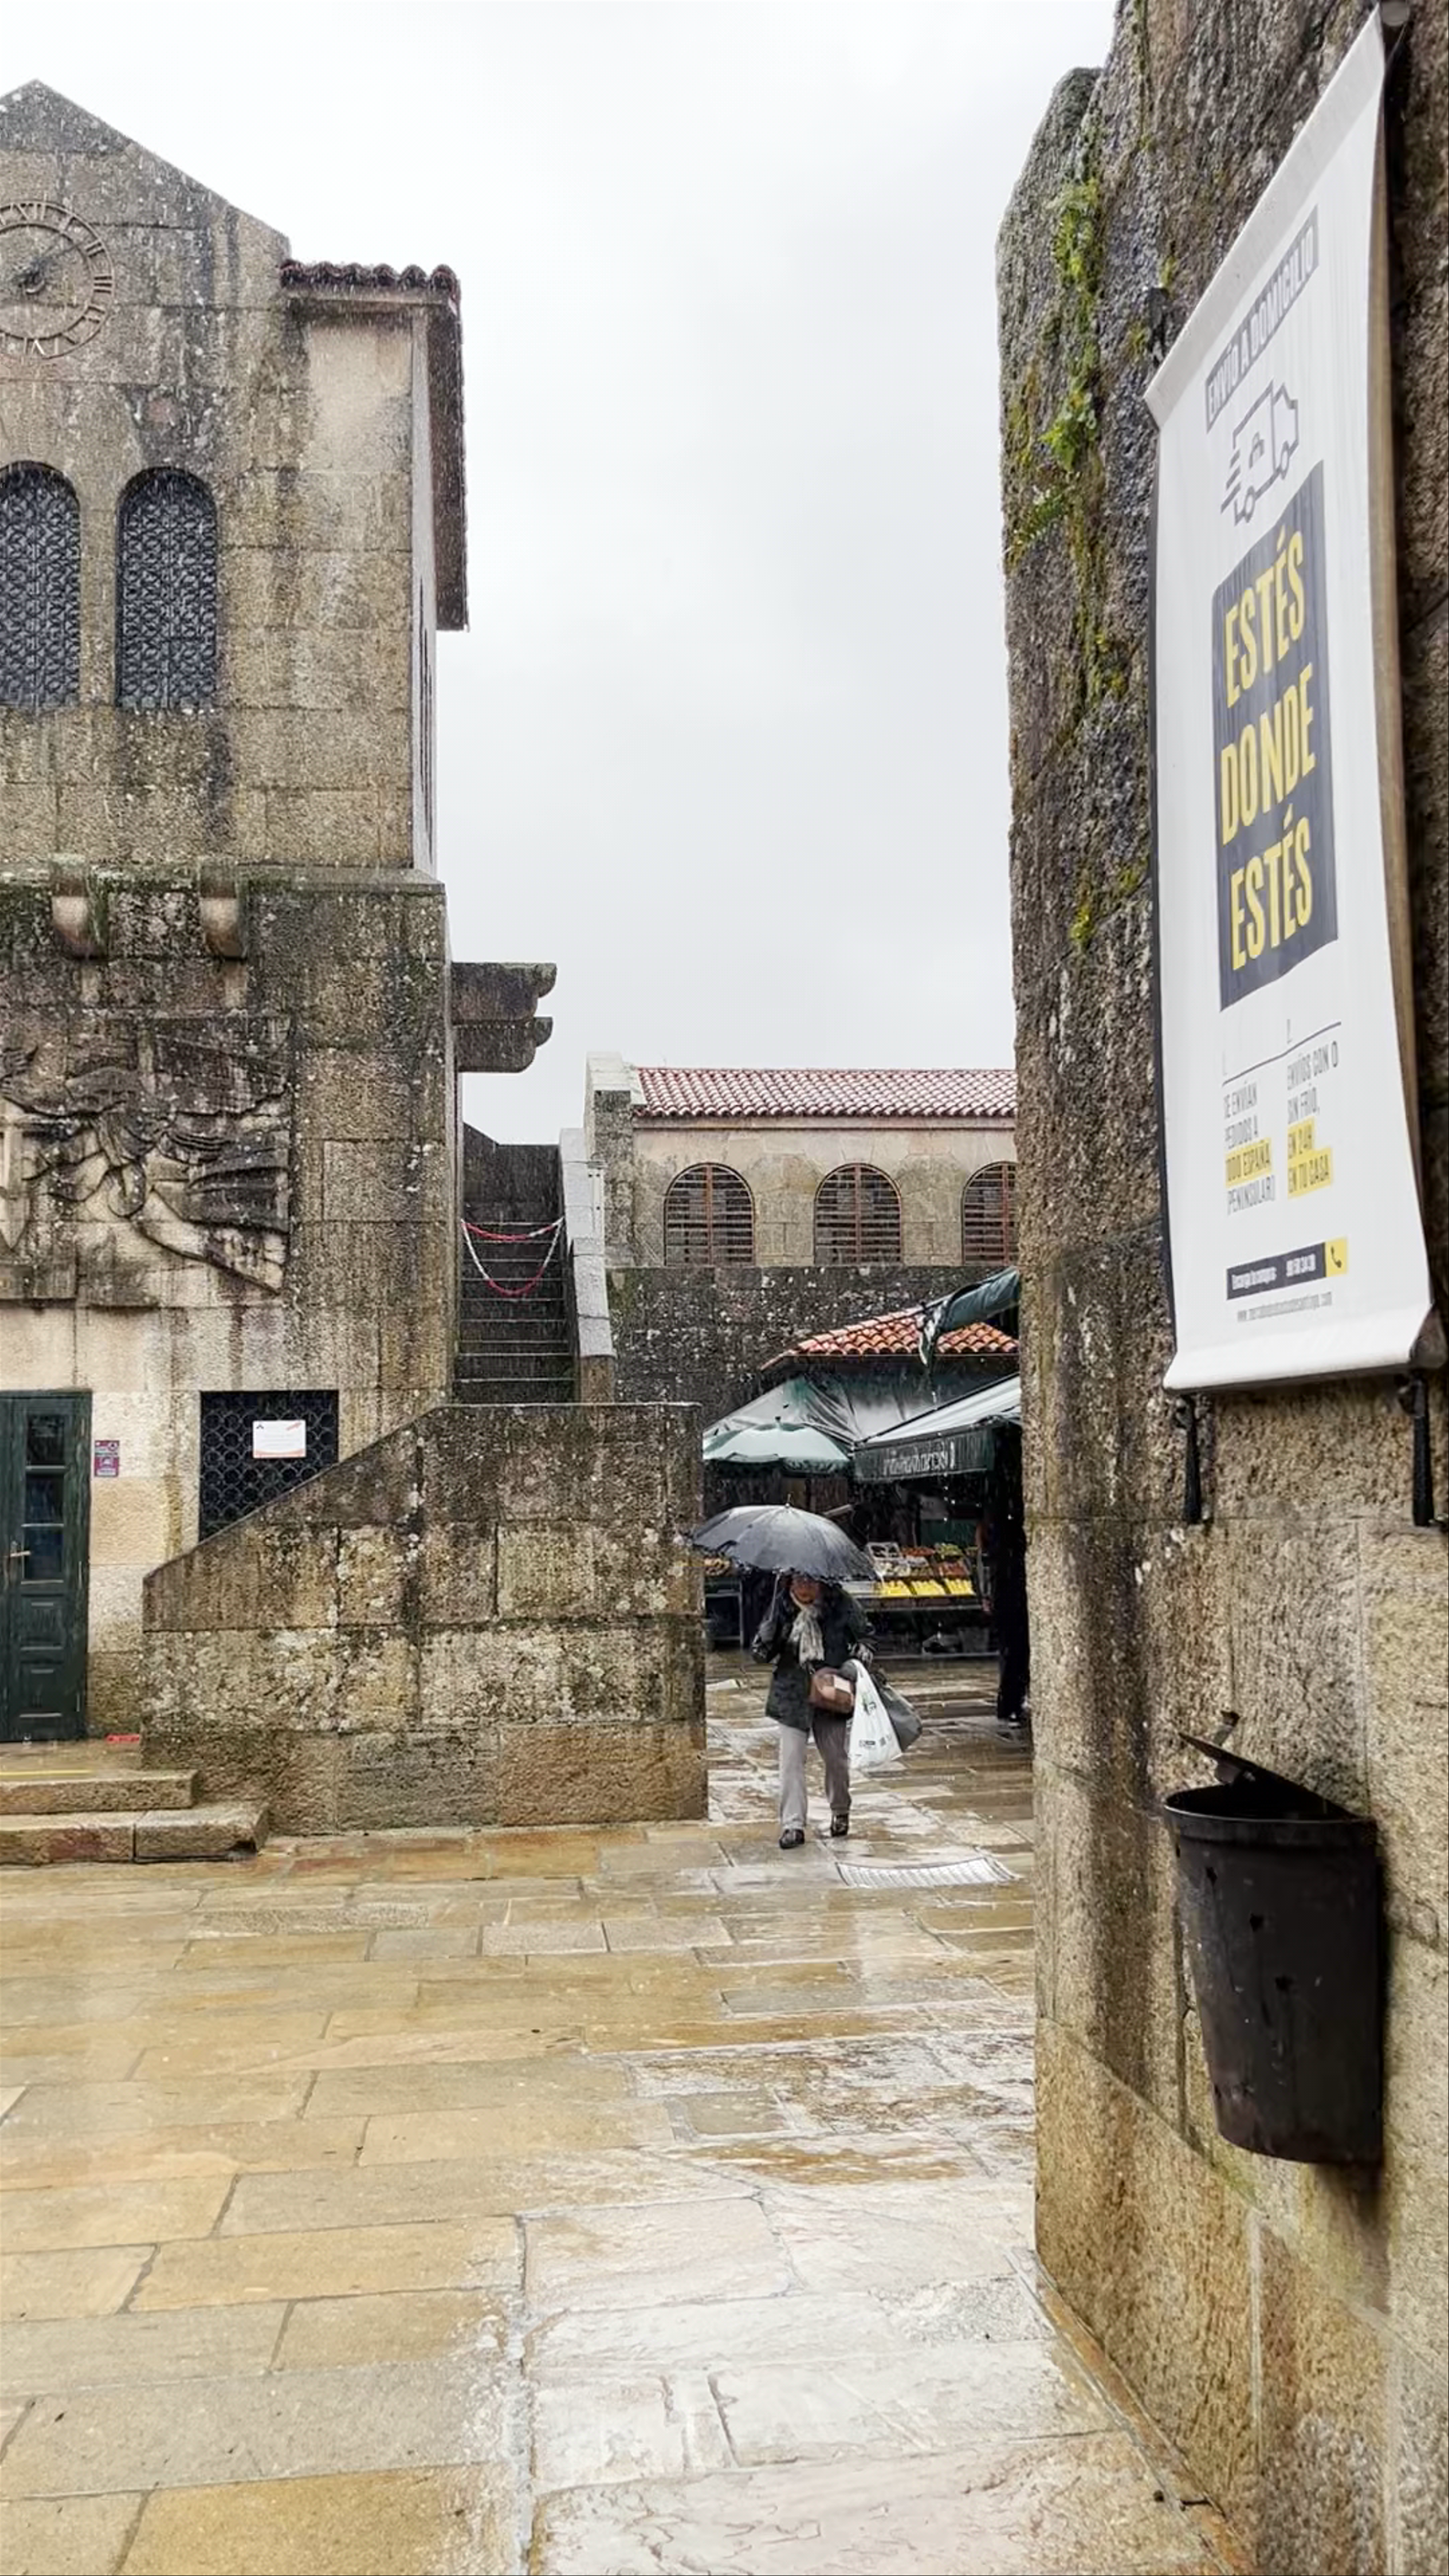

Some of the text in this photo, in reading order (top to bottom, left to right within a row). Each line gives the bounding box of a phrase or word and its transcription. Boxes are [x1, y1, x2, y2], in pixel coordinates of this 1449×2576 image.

[1241, 328, 1249, 375] A
[1250, 226, 1314, 358] DOMICILIO
[1225, 524, 1305, 708] ESTÉS
[1221, 662, 1316, 846] DONDE
[1231, 803, 1313, 970] ESTÉS
[1313, 1044, 1329, 1077] CON
[1331, 1041, 1338, 1067] O
[1253, 1115, 1259, 1138] A
[1288, 1132, 1297, 1159] EN
[1288, 1166, 1297, 1193] EN
